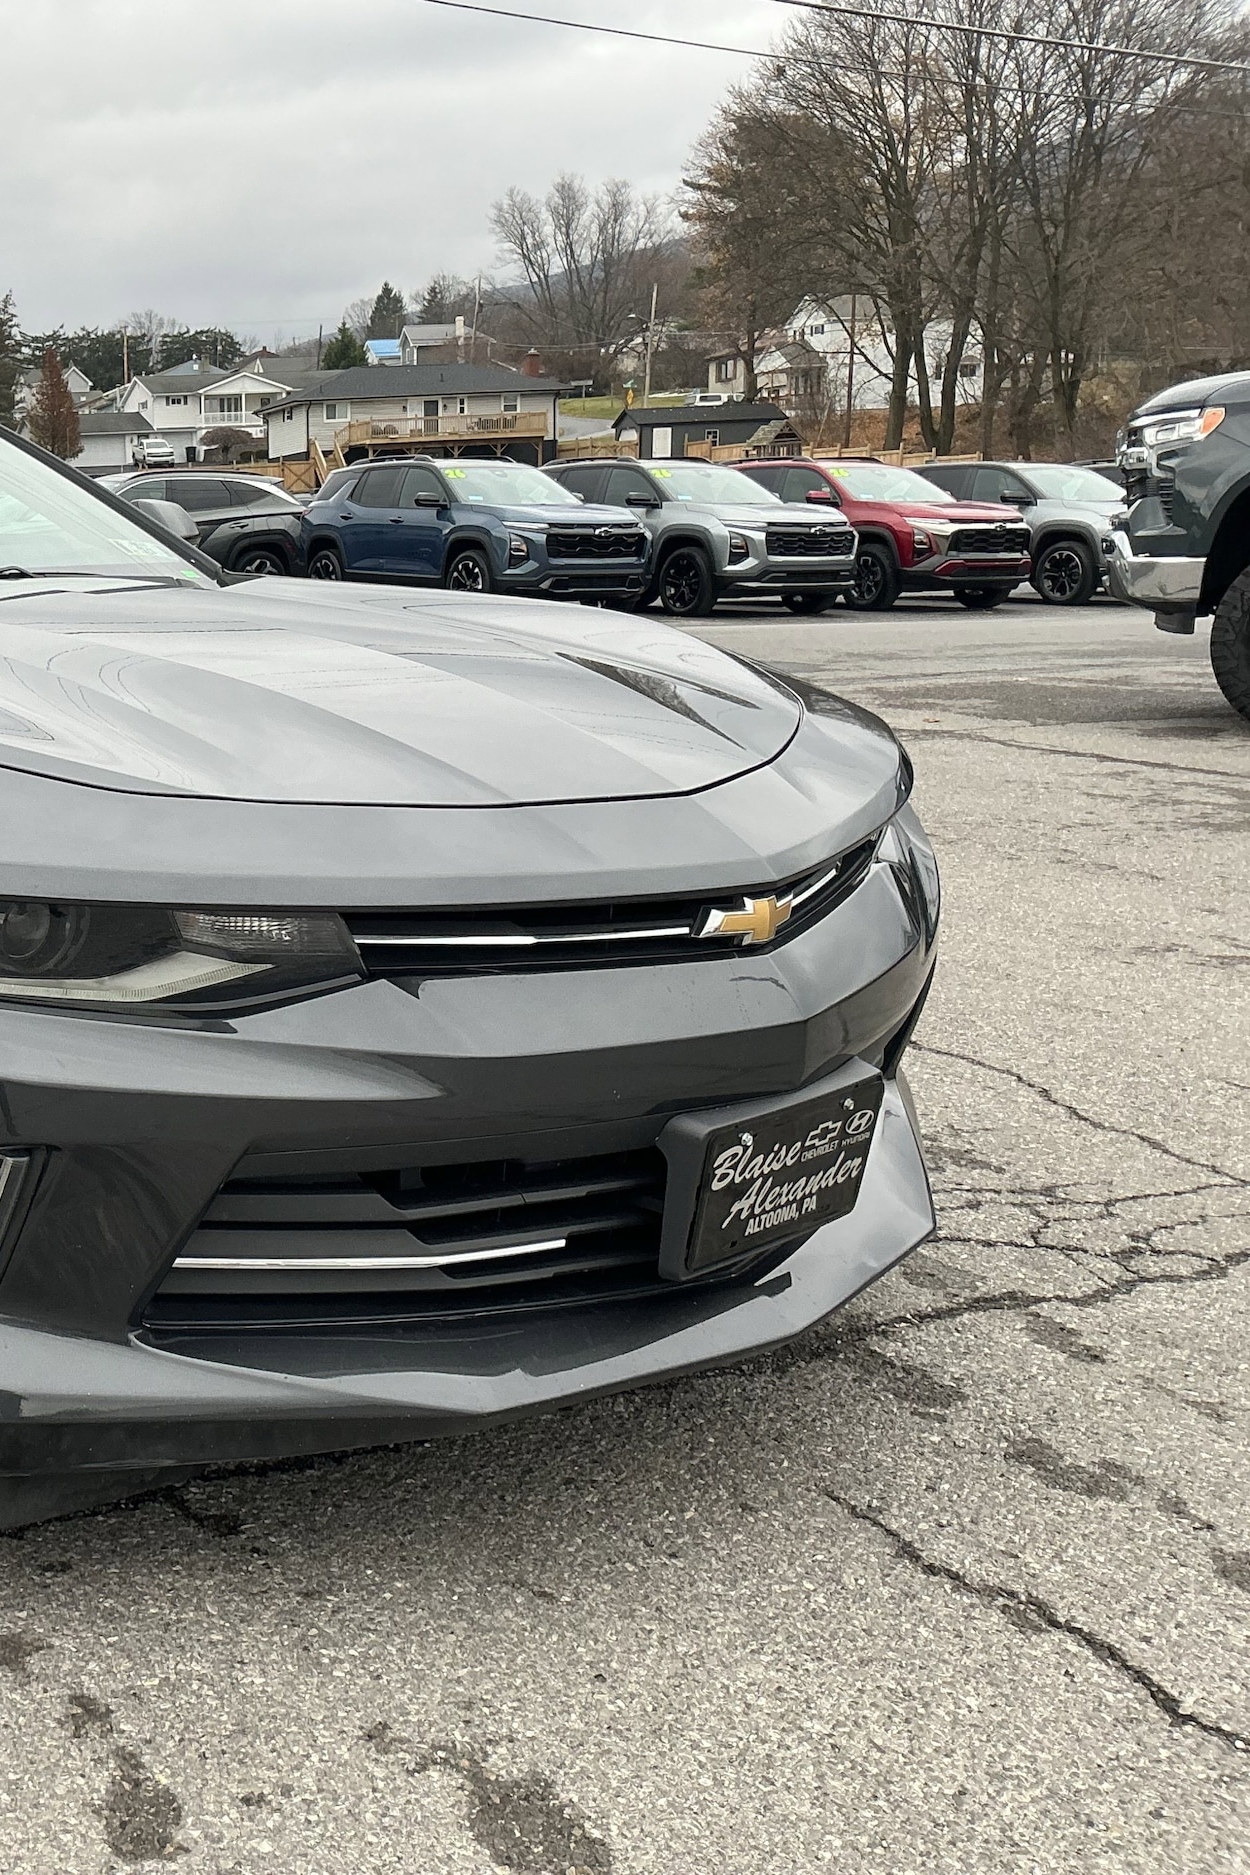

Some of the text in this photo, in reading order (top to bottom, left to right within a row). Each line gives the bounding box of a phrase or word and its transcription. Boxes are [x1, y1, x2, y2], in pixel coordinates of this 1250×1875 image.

[711, 1142, 801, 1191] Blaise
[801, 1140, 839, 1162] CHEVROLET
[721, 1151, 862, 1229] Alexander
[745, 1195, 817, 1236] ALTOONA, PA
